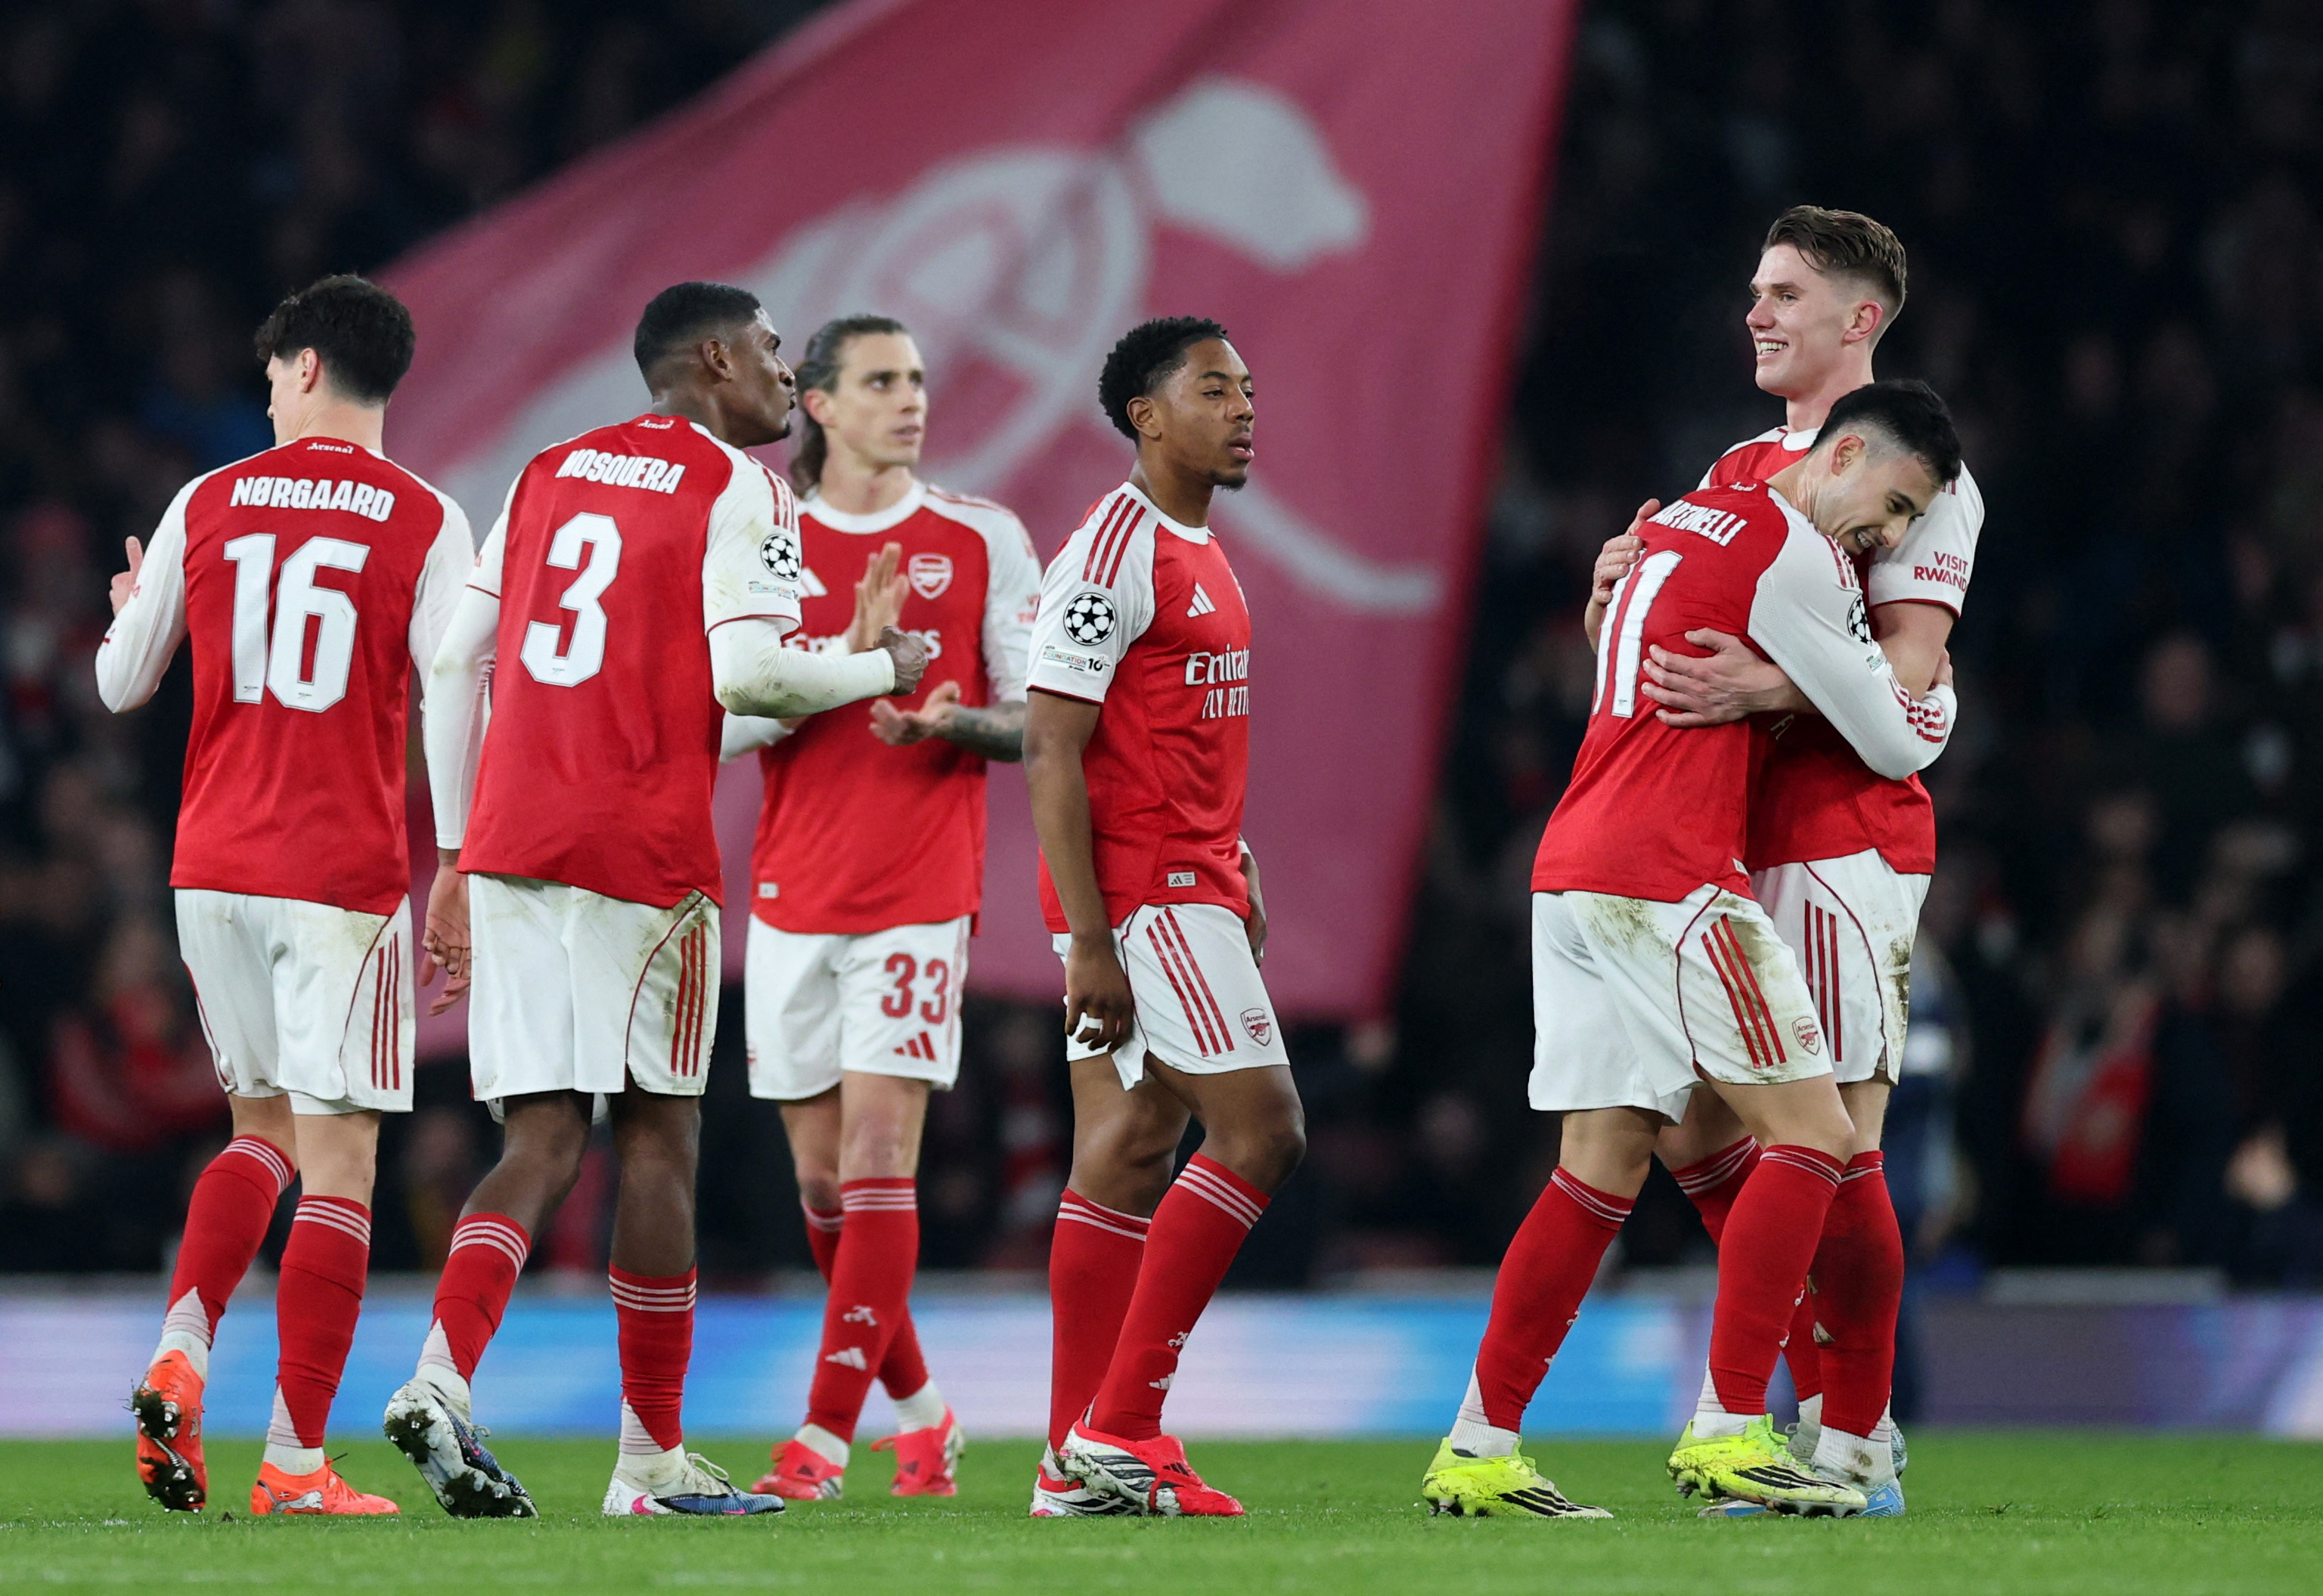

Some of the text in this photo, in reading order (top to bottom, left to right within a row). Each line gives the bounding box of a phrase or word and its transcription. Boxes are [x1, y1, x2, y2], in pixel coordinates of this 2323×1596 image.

[554, 448, 687, 495] MOSQUERA
[230, 476, 395, 522] NØRGAARD
[1646, 499, 1748, 547] ARTINELLI
[1914, 566, 1967, 593] RWAND
[1934, 550, 1968, 575] VISIT
[519, 512, 623, 687] 3
[224, 533, 371, 713] 16
[1185, 643, 1249, 685] Emirat
[1202, 686, 1249, 719] FLY BETT
[881, 953, 949, 1025] 33
